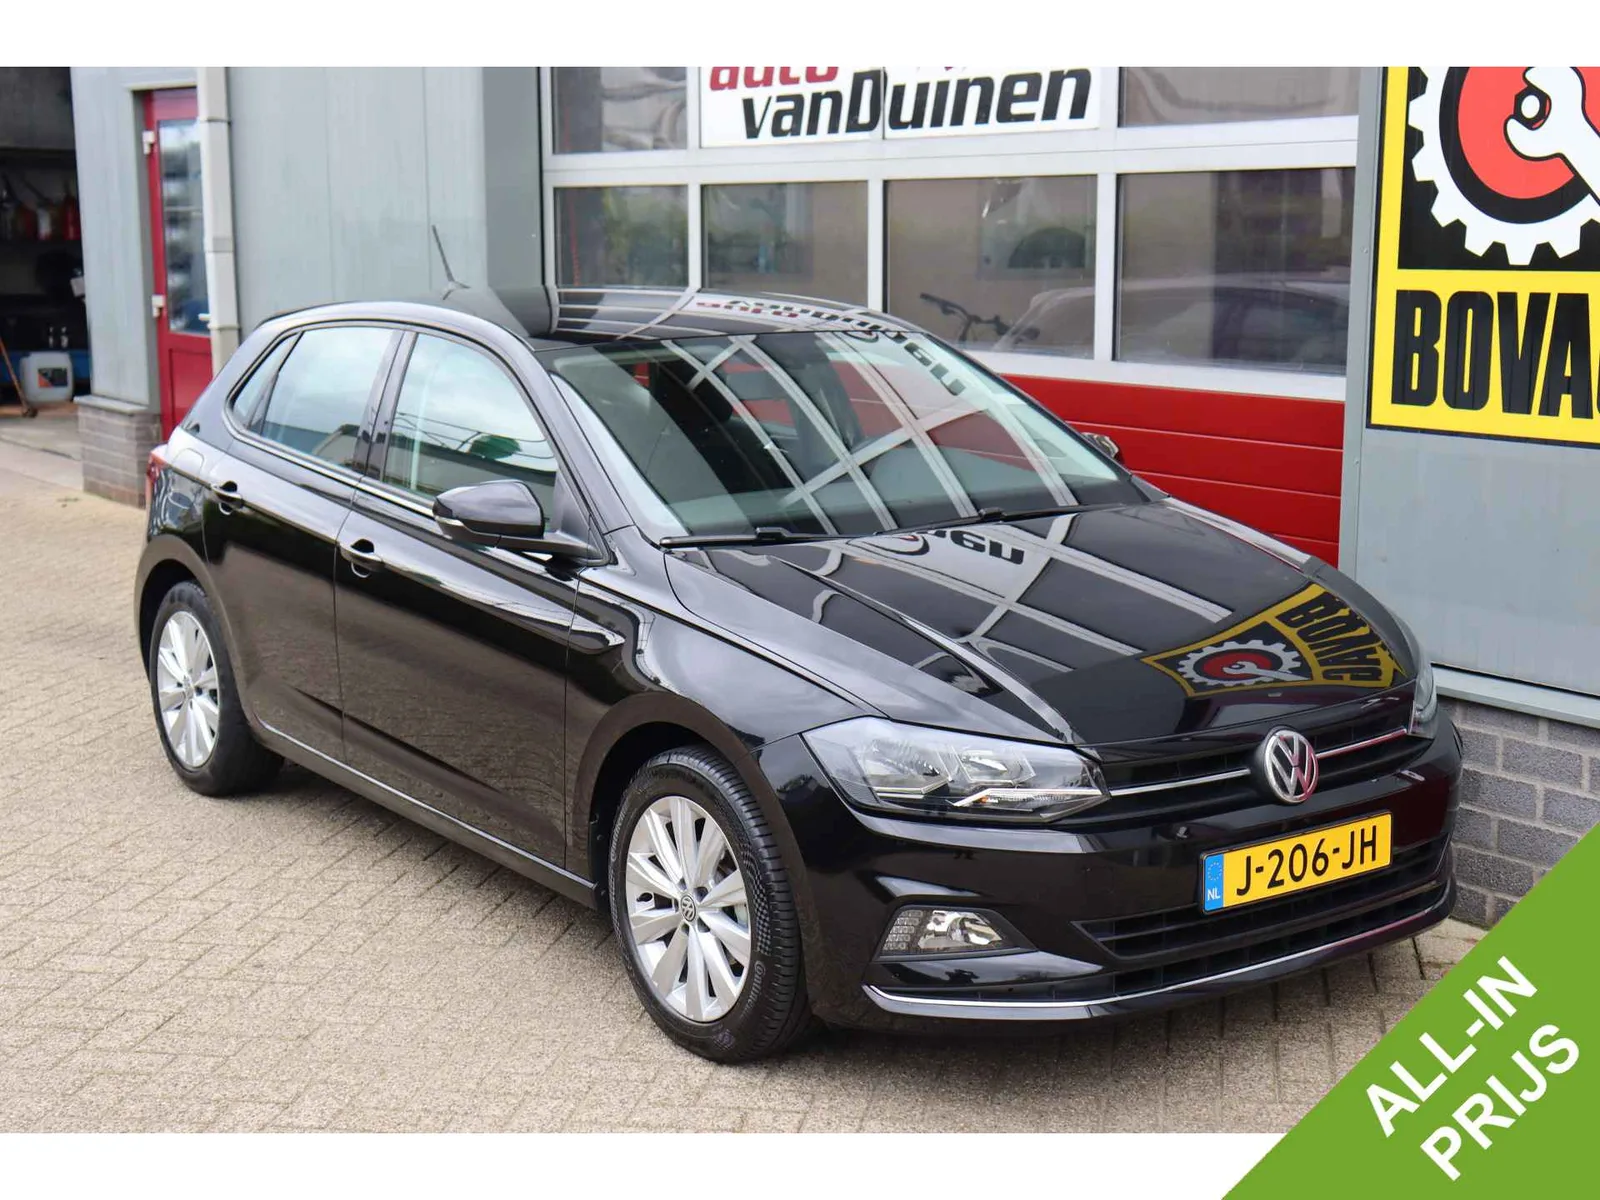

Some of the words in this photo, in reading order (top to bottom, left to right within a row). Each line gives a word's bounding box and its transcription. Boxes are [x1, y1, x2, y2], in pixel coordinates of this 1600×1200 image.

[742, 67, 1092, 140] vanDuinen
[1391, 288, 1600, 420] BOVA
[1207, 887, 1221, 900] NL
[1236, 825, 1377, 897] J-206-JH
